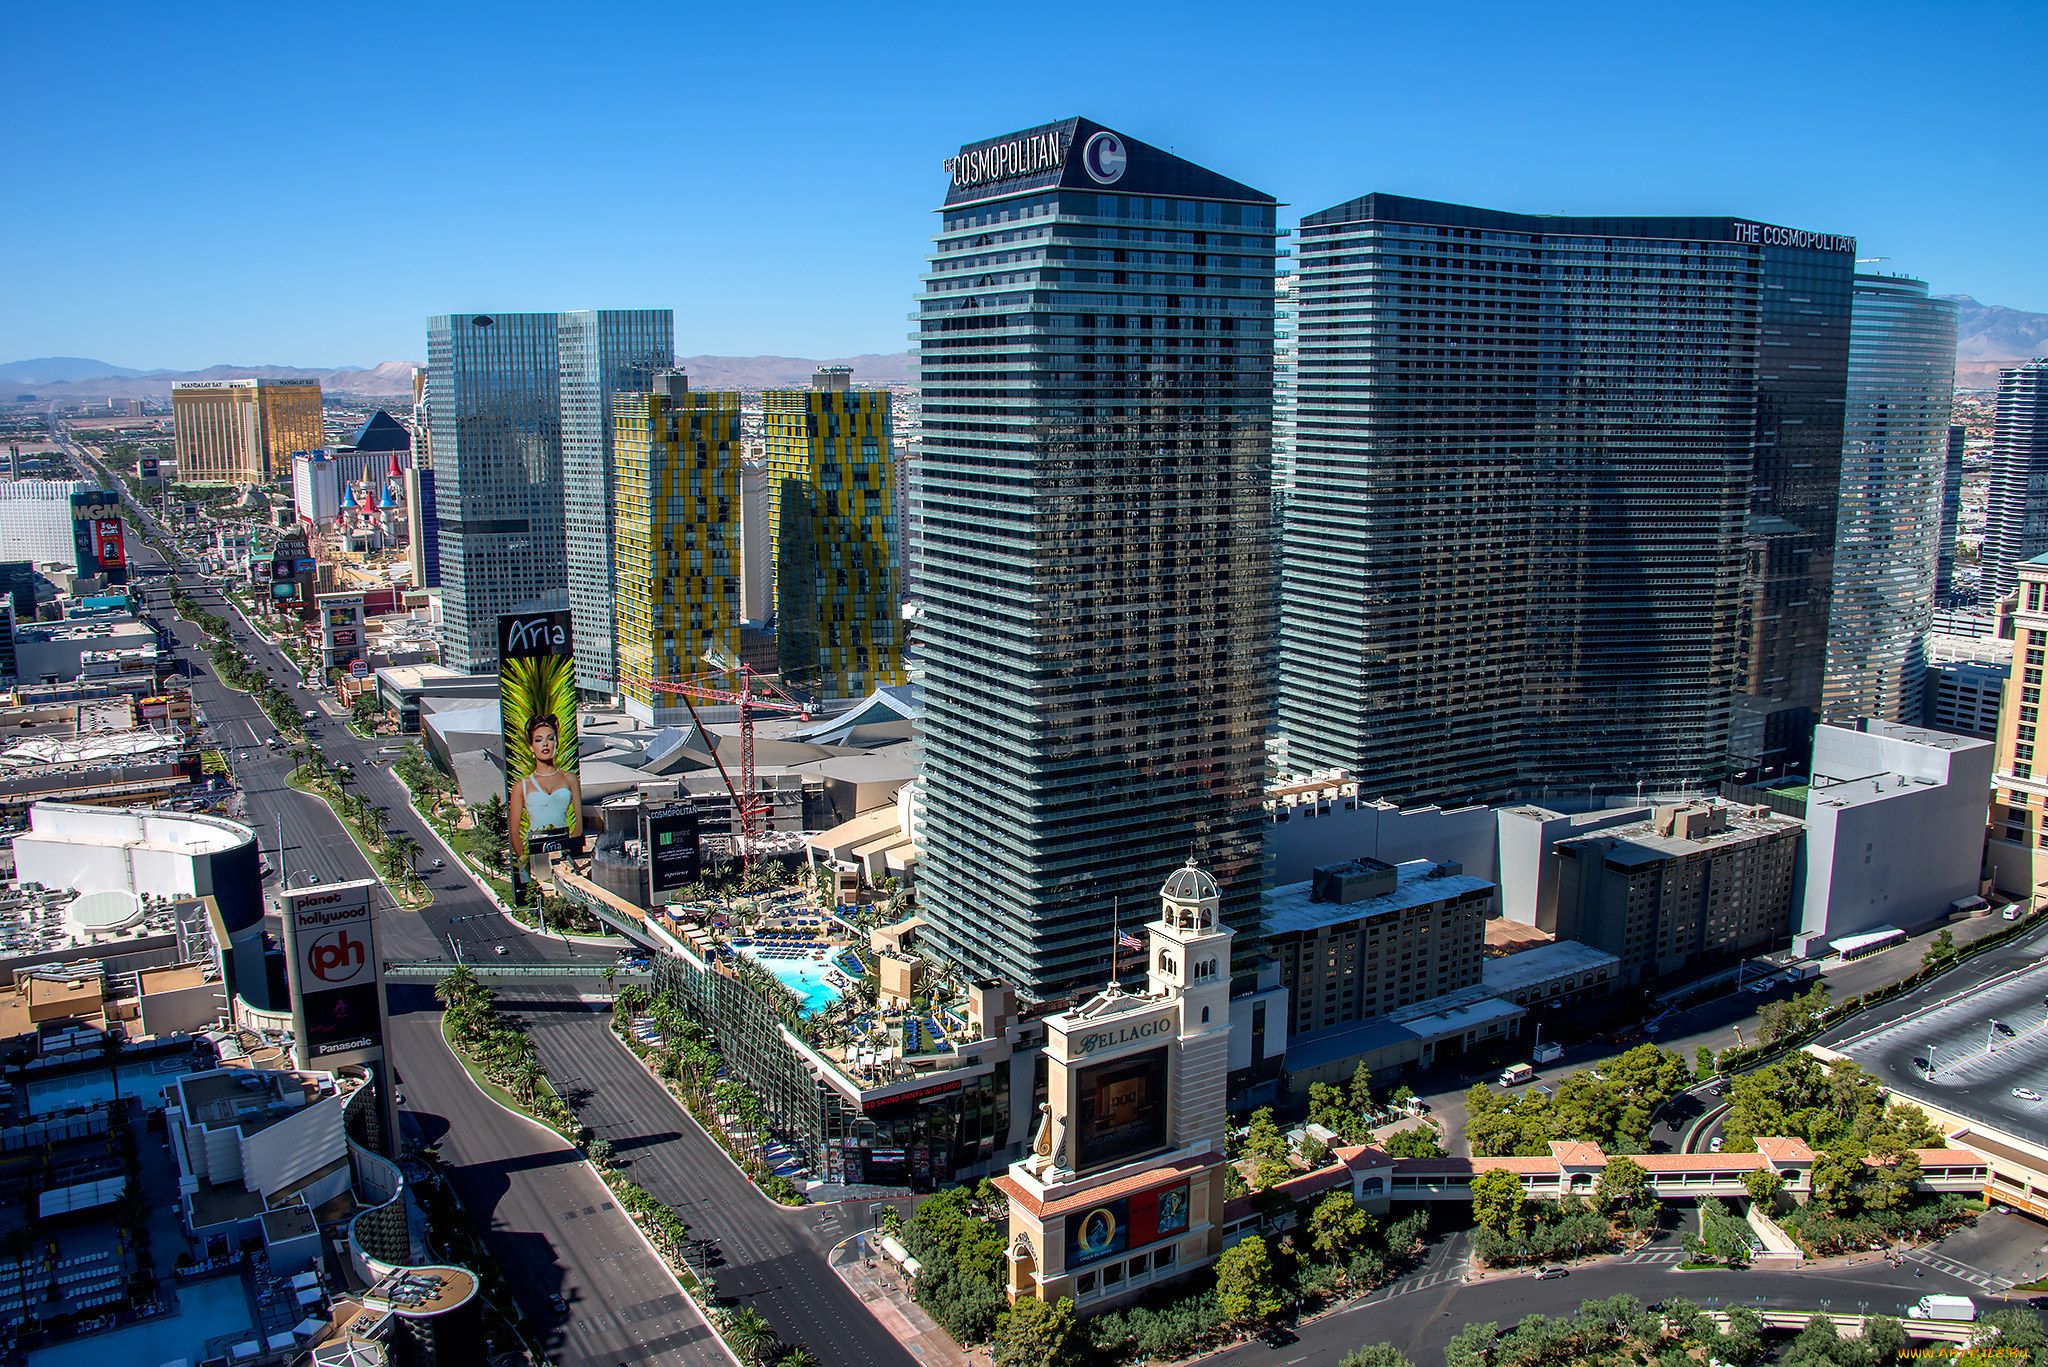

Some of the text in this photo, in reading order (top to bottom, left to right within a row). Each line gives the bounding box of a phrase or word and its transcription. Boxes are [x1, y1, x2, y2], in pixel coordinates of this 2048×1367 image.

[953, 131, 1060, 187] COSMOPOLITAN
[1734, 222, 1856, 253] THE COSMOPOLITAN
[72, 504, 122, 520] MGM
[508, 618, 566, 652] Aria
[650, 804, 698, 820] COSMOPOLITAN
[542, 841, 562, 853] Aria
[297, 892, 342, 911] planet
[299, 906, 366, 925] hollywood
[314, 930, 365, 981] ph
[319, 1038, 372, 1054] Panasonic
[1074, 1018, 1171, 1055] BELLAGIO
[876, 1096, 900, 1107] SKIING
[901, 1090, 923, 1101] PANTS
[924, 1086, 942, 1095] WITH
[942, 1081, 961, 1091] SHOU
[1078, 1208, 1116, 1252] O
